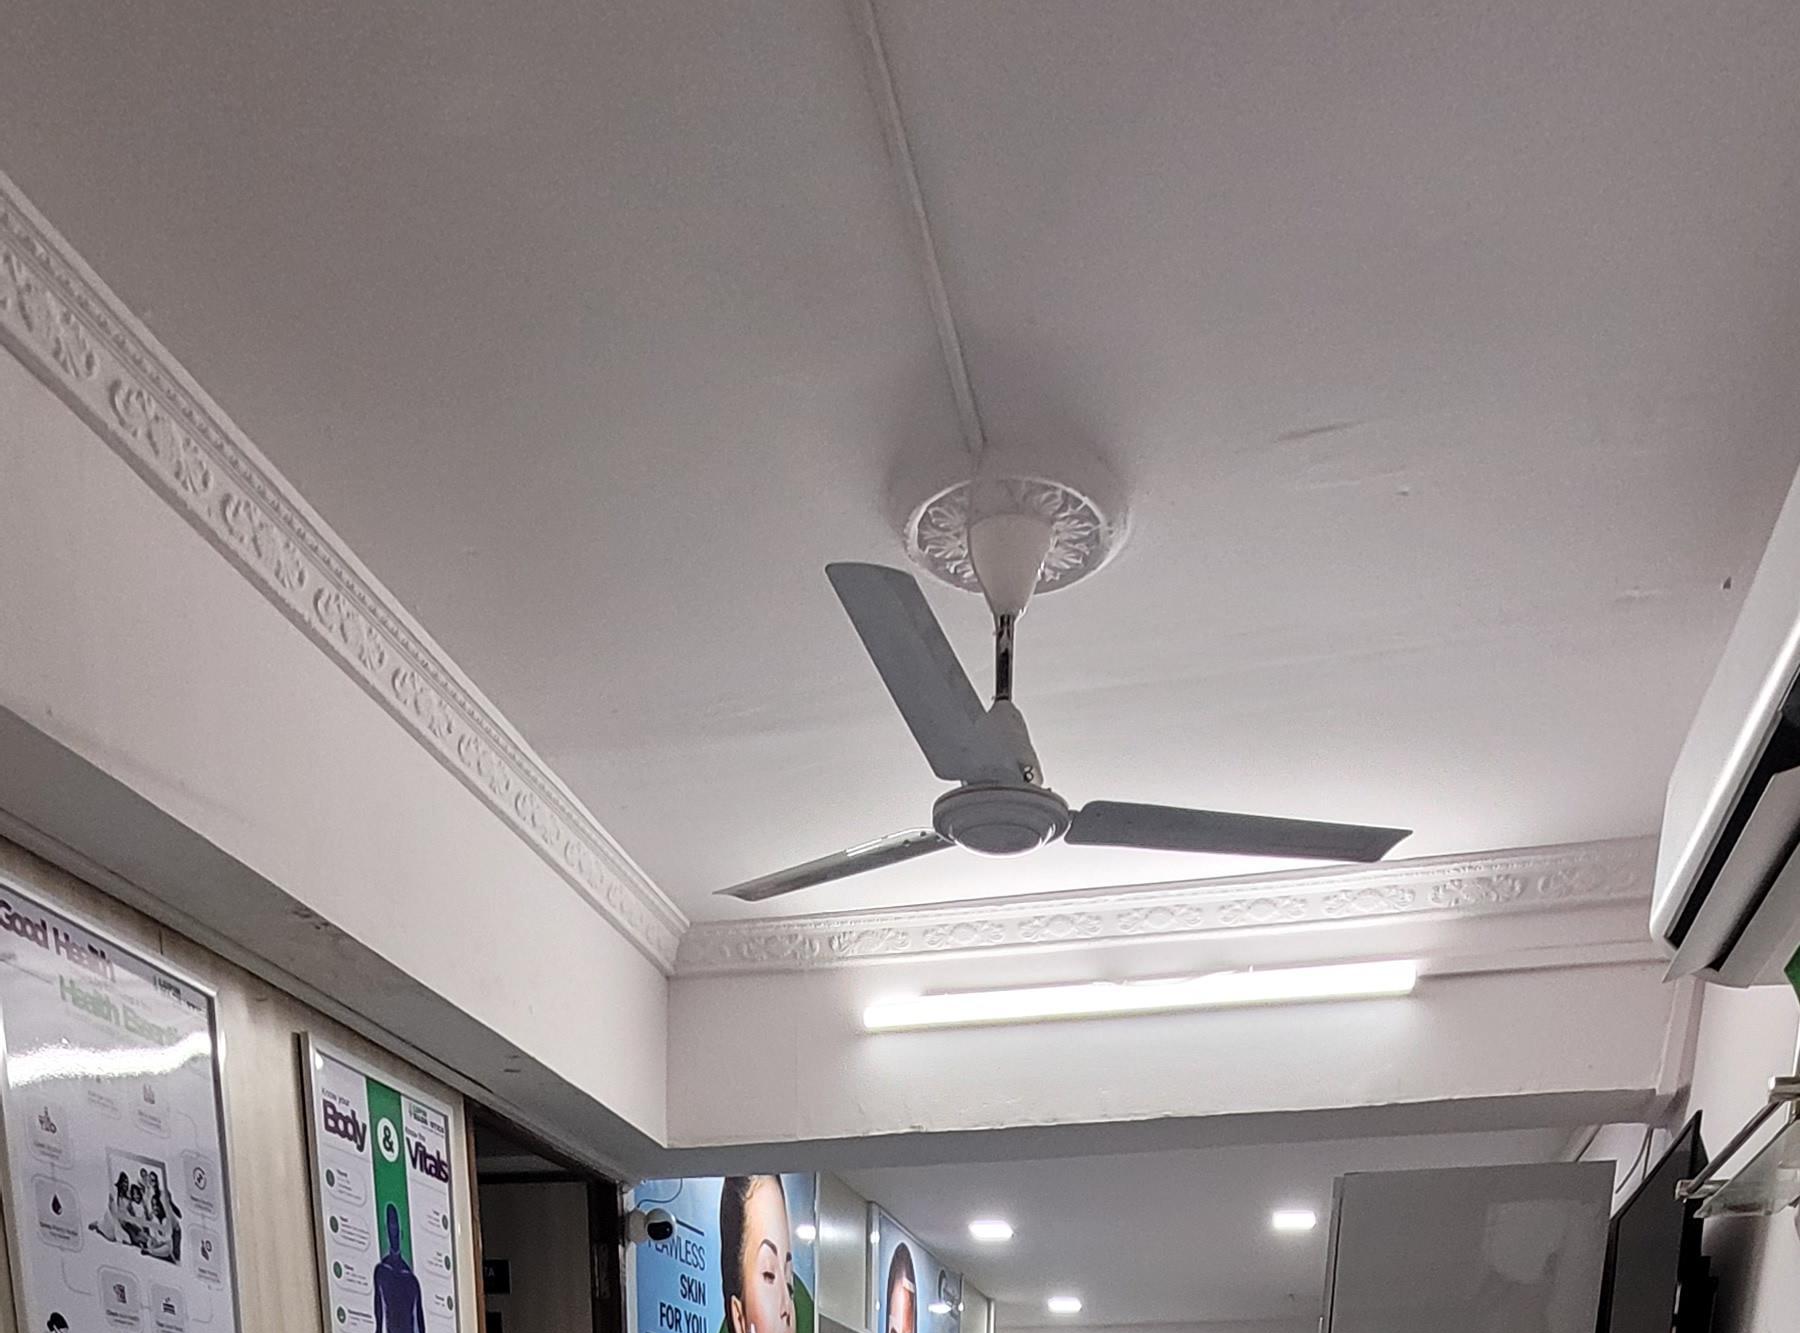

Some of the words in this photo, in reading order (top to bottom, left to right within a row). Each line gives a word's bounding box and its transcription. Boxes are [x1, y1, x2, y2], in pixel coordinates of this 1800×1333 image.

[322, 1098, 367, 1153] Body
[382, 1125, 394, 1154] &
[405, 1135, 449, 1183] Vitals
[679, 1273, 706, 1307] SKIN
[659, 1301, 682, 1333] FOR
